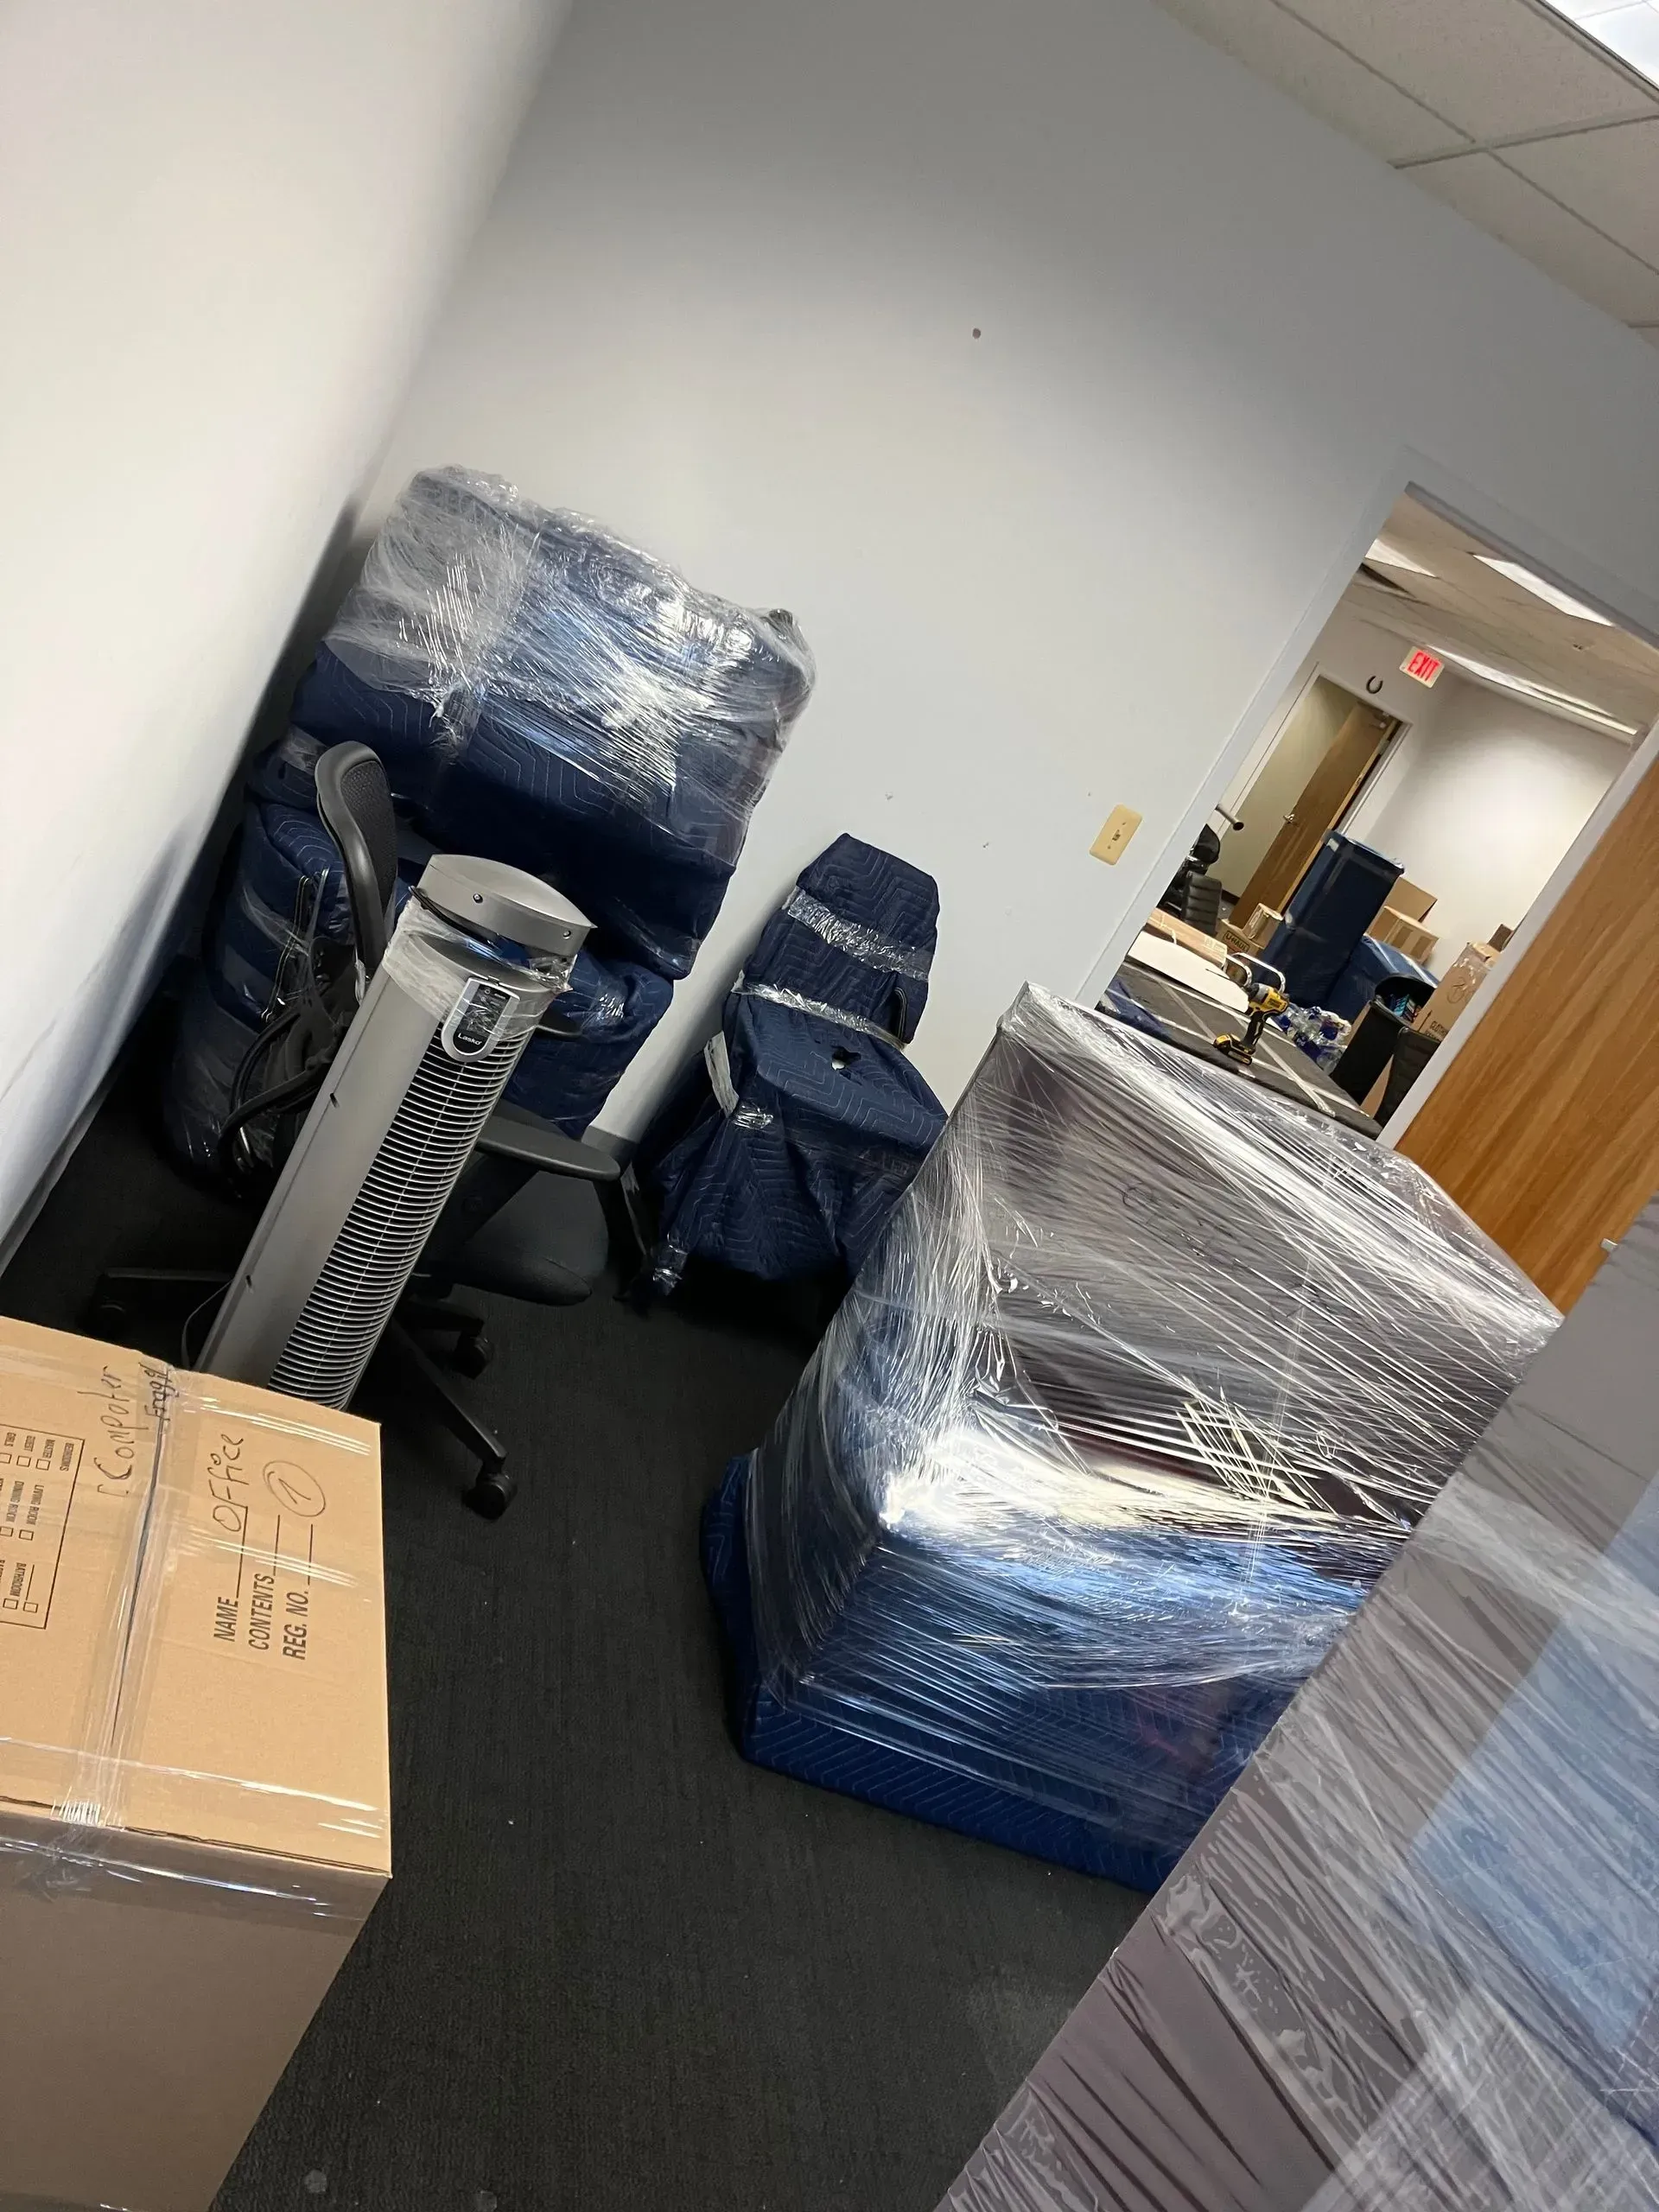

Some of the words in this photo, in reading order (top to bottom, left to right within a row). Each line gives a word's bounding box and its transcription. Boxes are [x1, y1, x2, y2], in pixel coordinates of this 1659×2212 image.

[1408, 652, 1440, 682] EXIT
[458, 1033, 482, 1046] Lasko
[3, 1432, 16, 1447] GIRLS
[23, 1434, 35, 1452] GUEST
[42, 1439, 55, 1459] MASTER
[10, 1480, 24, 1503] DINING
[30, 1484, 44, 1505] LIVING
[5, 1503, 19, 1522] ROOM
[26, 1506, 40, 1525] ROOM
[10, 1562, 27, 1598] BATHROOM
[248, 1573, 275, 1651] CONTENTS
[285, 1589, 309, 1617] NO.
[213, 1597, 239, 1642] NAME
[282, 1624, 308, 1661] REG.
